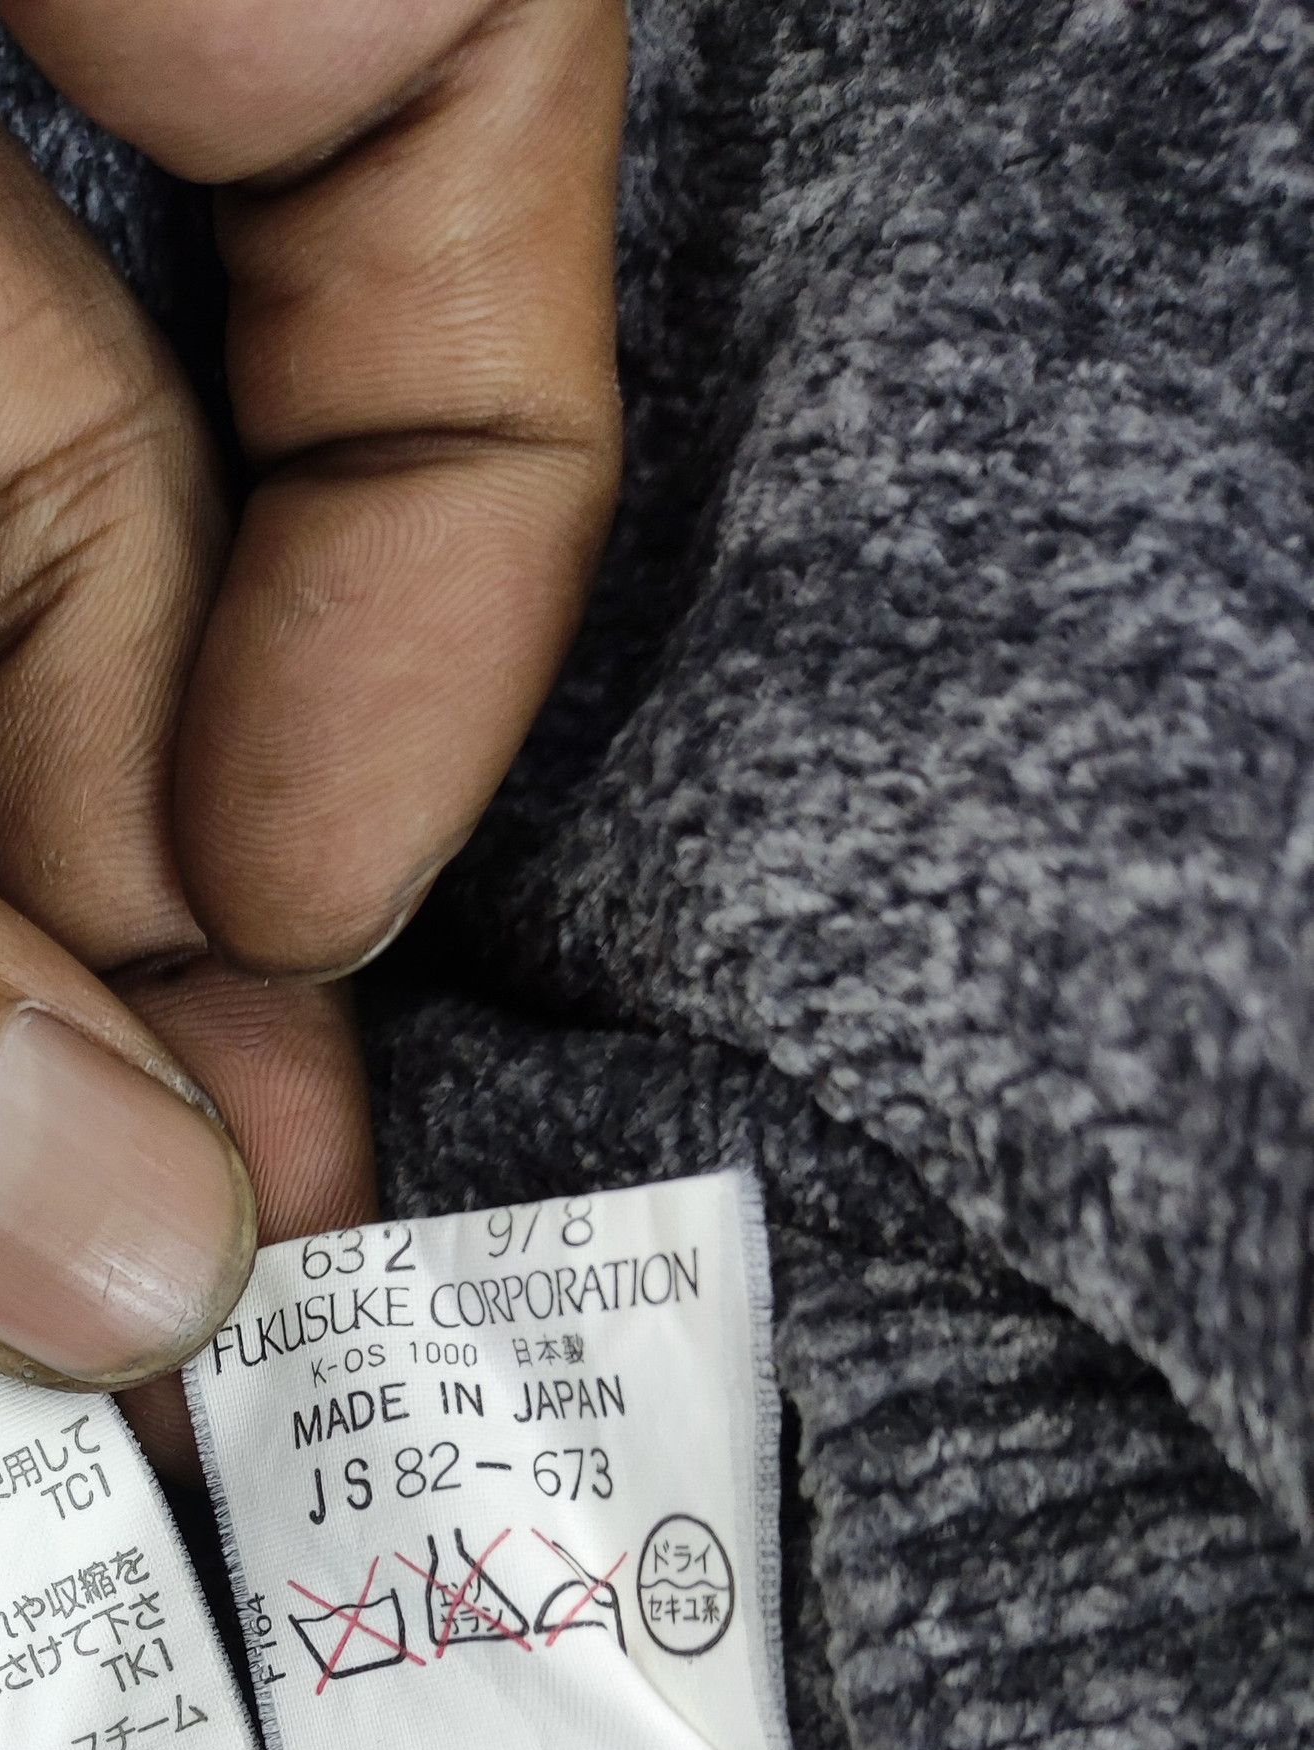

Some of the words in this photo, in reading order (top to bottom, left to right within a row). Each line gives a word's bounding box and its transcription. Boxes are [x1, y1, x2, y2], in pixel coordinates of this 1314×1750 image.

[212, 1286, 414, 1376] FUKUSUKE
[429, 1247, 699, 1329] CORPORATION
[408, 1341, 478, 1367] 1000
[512, 1333, 585, 1368] 日本製
[292, 1381, 411, 1450] MADE
[439, 1380, 485, 1417] IN
[513, 1374, 626, 1424] JAPAN
[40, 1462, 112, 1520] TC1
[653, 1539, 712, 1575] ドライ
[100, 1637, 174, 1693] TK1
